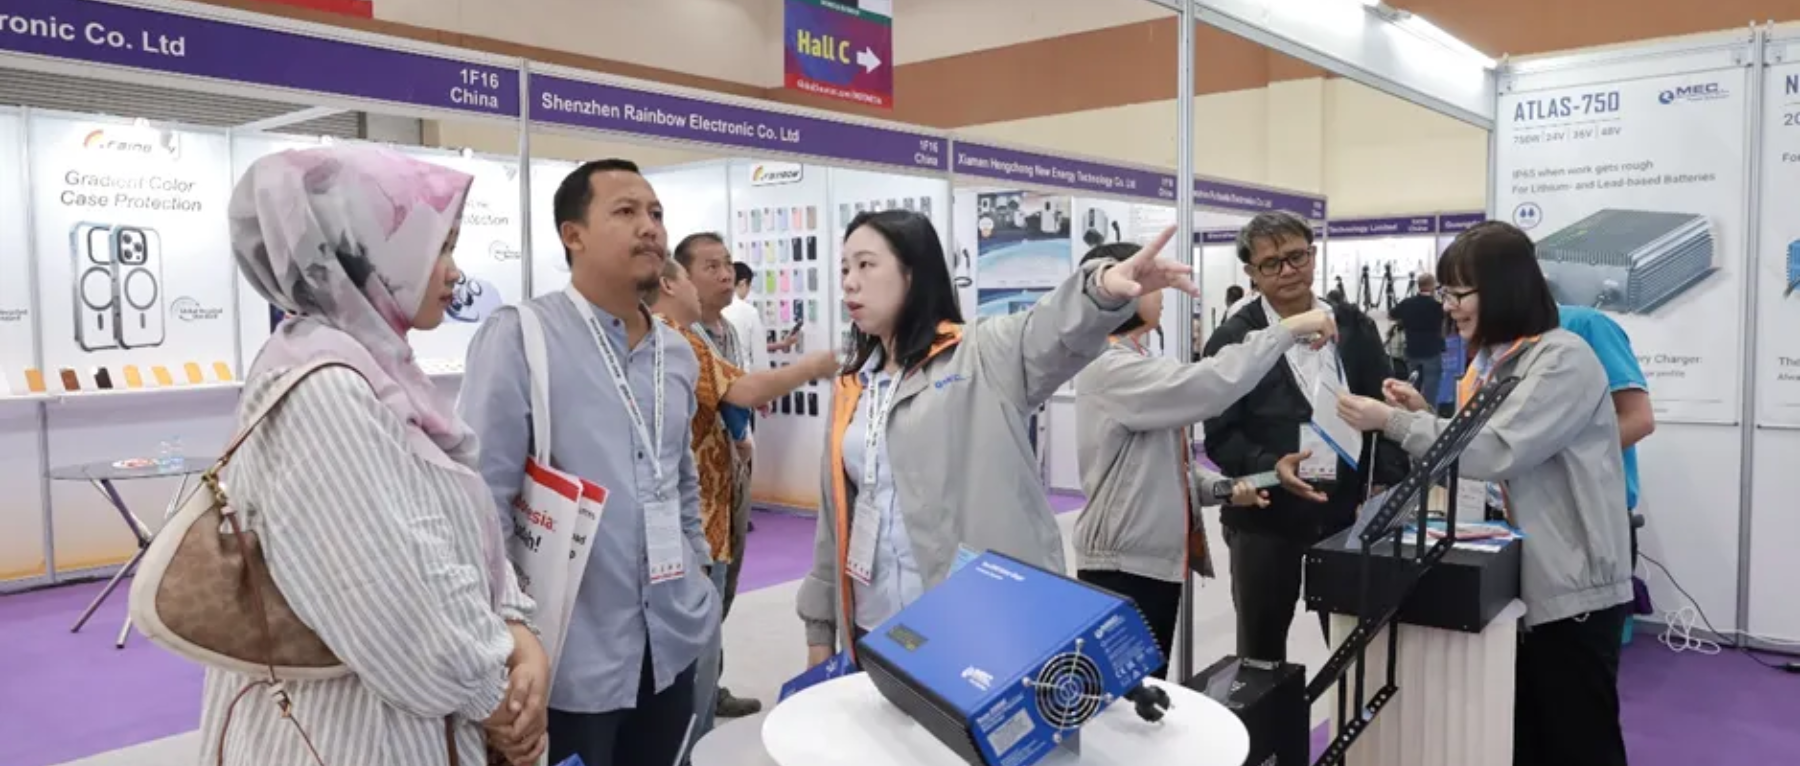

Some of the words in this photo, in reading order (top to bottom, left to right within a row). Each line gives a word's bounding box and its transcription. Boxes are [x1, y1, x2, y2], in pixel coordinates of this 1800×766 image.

[84, 22, 133, 49] Co.
[142, 31, 185, 56] Ltd
[797, 29, 835, 60] Hall
[839, 40, 850, 64] C
[460, 69, 499, 89] 1F16
[1676, 83, 1718, 95] MEC
[450, 86, 499, 108] China
[1513, 91, 1621, 122] ATLAS-750
[541, 92, 621, 119] Shenzhen
[624, 104, 686, 128] Rainbow
[689, 114, 754, 137] Electronic
[757, 124, 777, 140] Co.
[780, 127, 800, 142] Ltd
[1546, 131, 1565, 142] 24V
[914, 153, 938, 166] China
[958, 152, 989, 168] Xiamen
[1512, 168, 1536, 179] IP65
[1538, 167, 1565, 178] when
[1568, 164, 1592, 175] work
[1595, 163, 1619, 175] gets
[1621, 158, 1654, 172] rough
[64, 169, 145, 189] Gradient
[149, 176, 196, 193] Color
[1512, 184, 1529, 195] For
[1575, 179, 1595, 190] and
[1596, 175, 1661, 190] Lead-based
[1663, 172, 1716, 184] Batteries
[60, 189, 108, 208] Case
[114, 193, 203, 212] Protection
